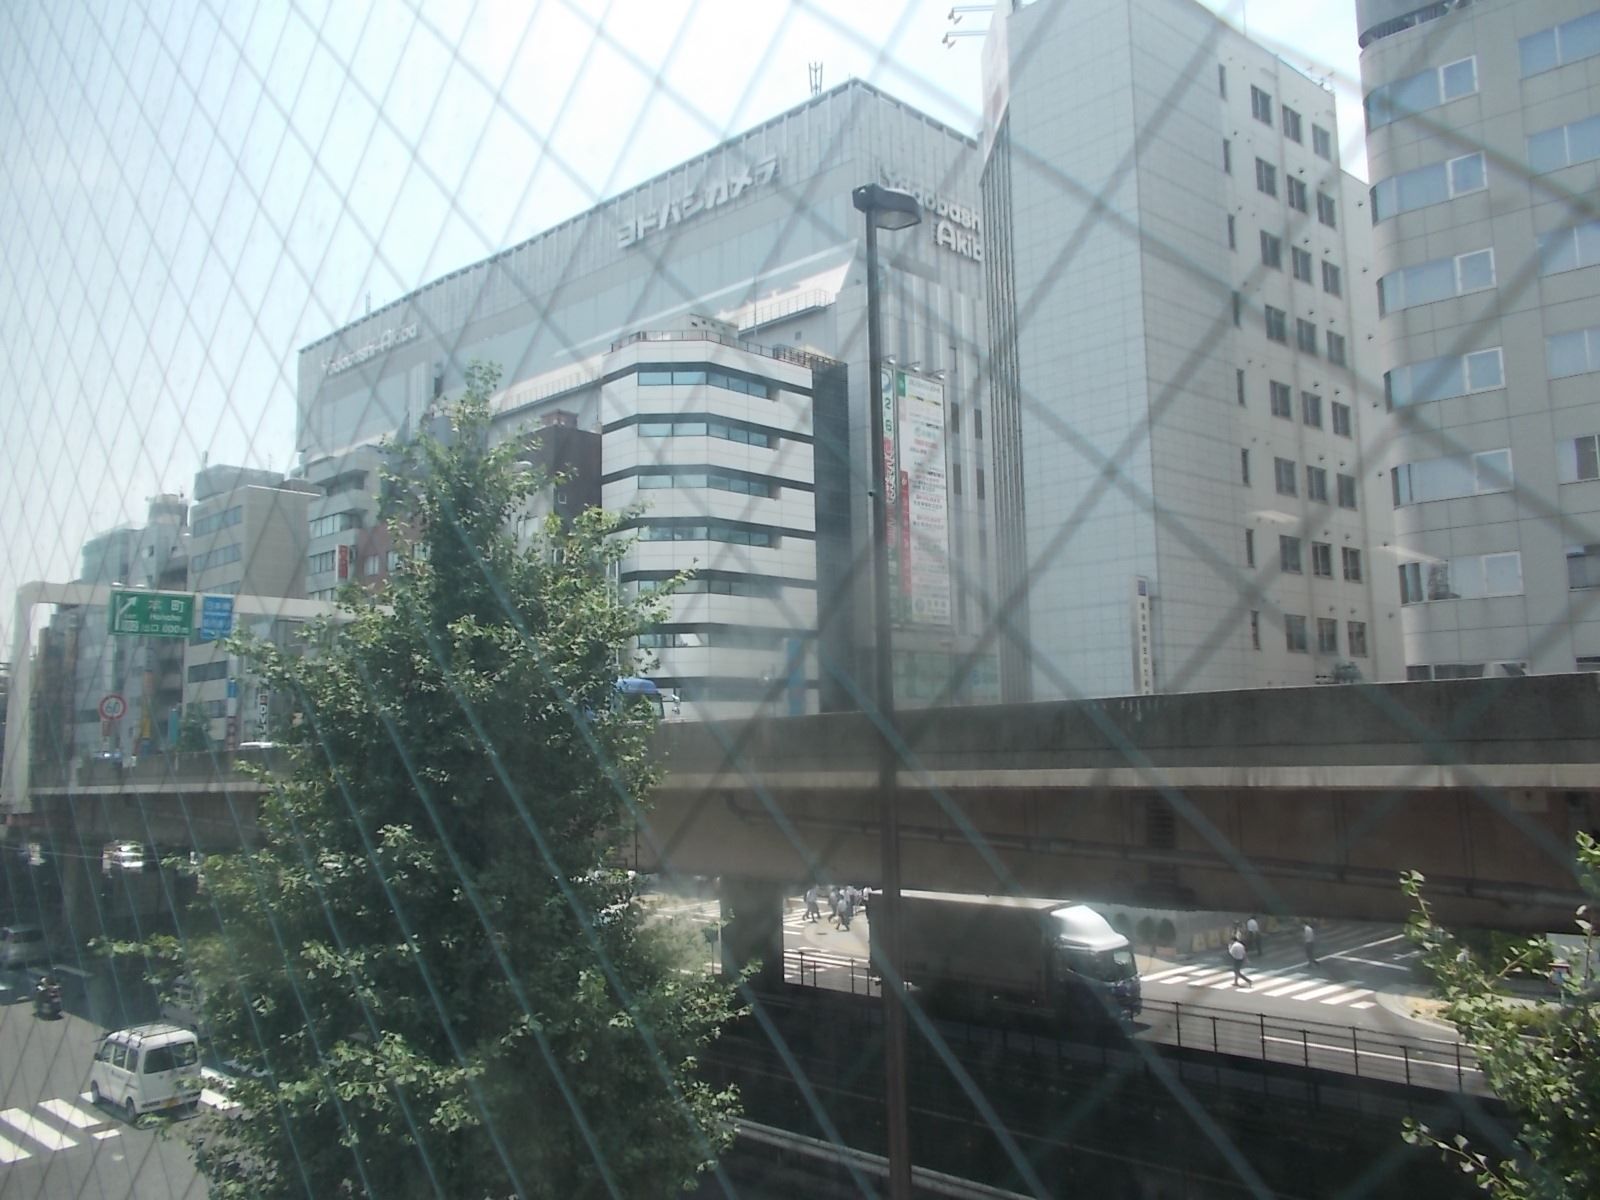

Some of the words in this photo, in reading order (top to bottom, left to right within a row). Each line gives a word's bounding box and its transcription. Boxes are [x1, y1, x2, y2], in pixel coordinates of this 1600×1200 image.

[617, 154, 777, 248] ヨドバシカメラ
